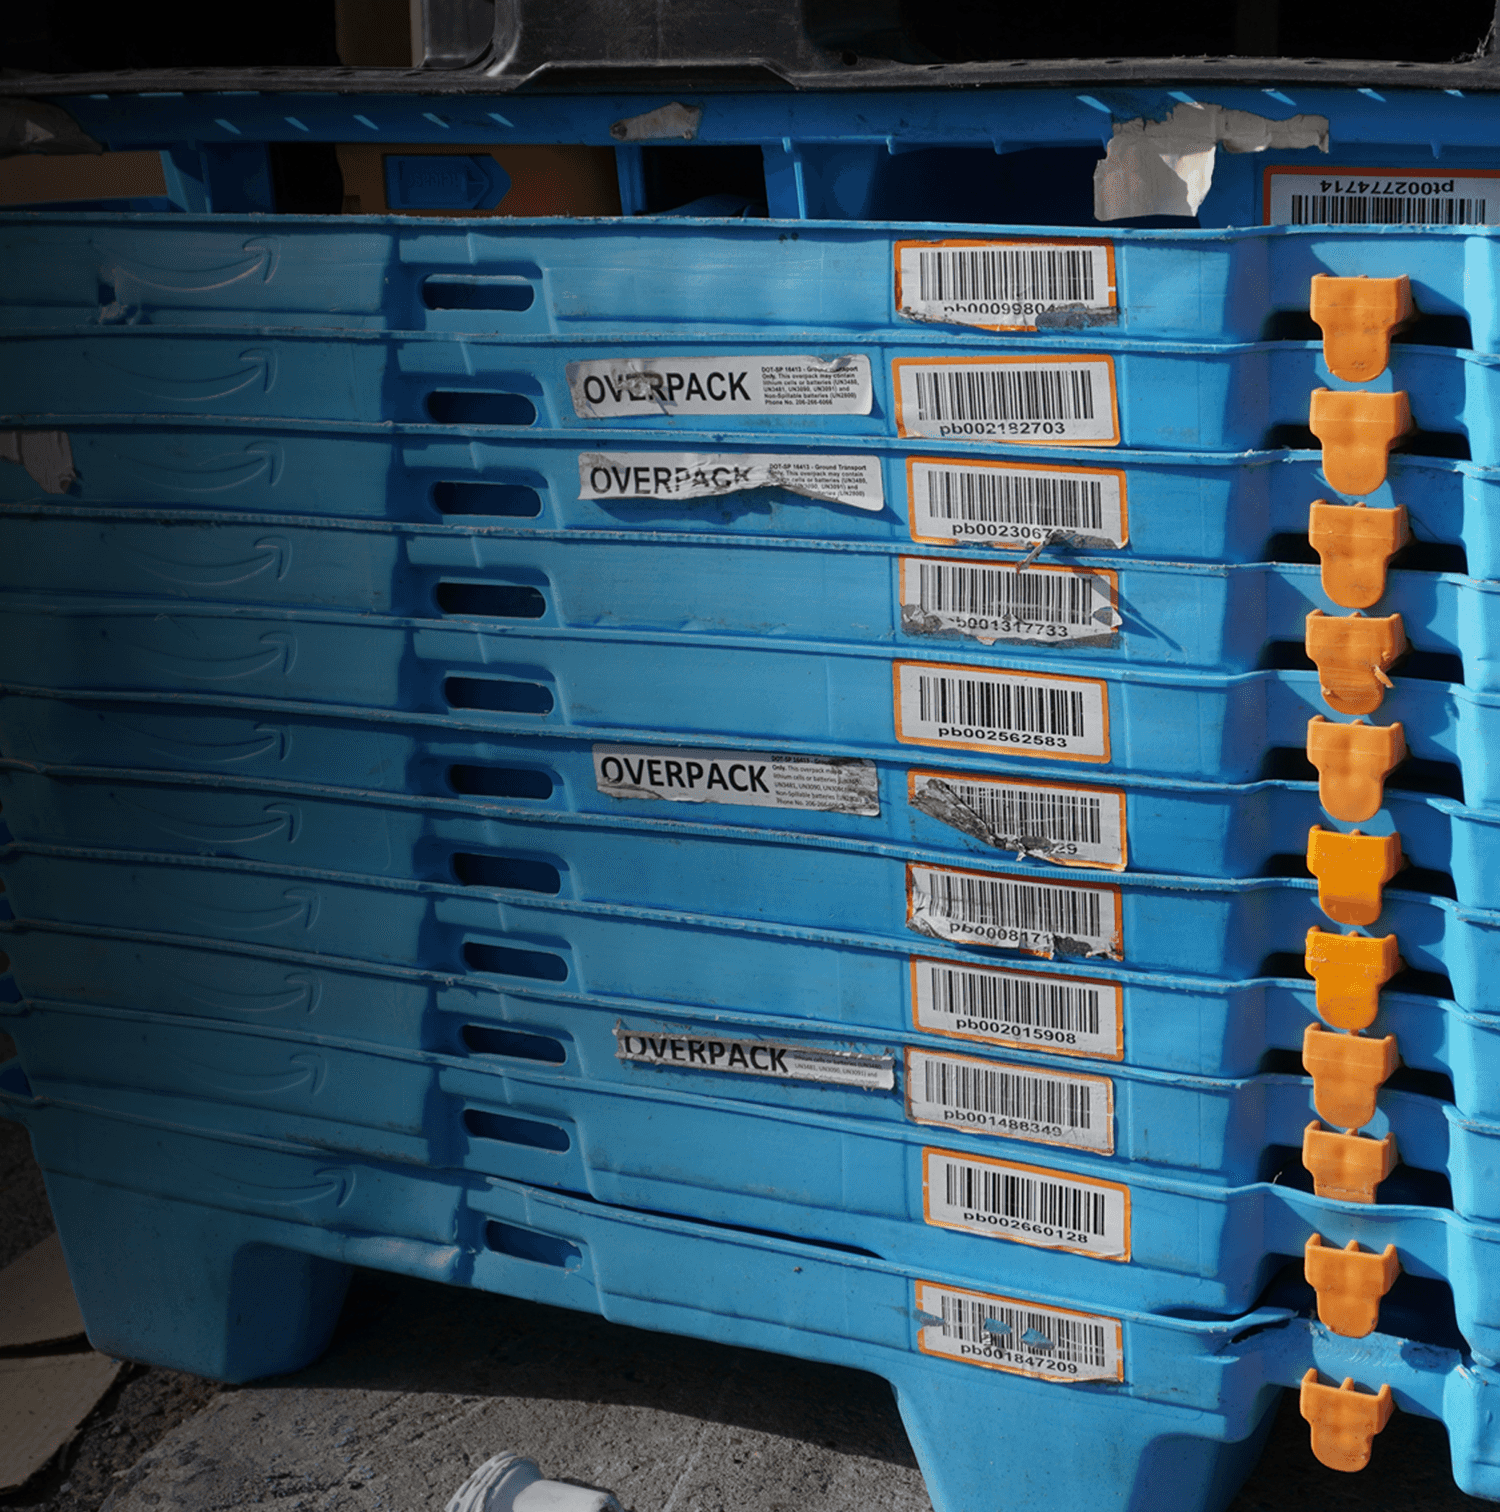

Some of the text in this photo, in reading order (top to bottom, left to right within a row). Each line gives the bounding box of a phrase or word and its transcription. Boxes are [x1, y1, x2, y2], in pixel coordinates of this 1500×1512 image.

[1319, 180, 1455, 195] pt002774714
[583, 371, 752, 405] OVERPACK
[939, 421, 1067, 437] pb002182703
[590, 465, 754, 495] OVERPACK
[952, 522, 1077, 540] pb0023067
[947, 616, 1069, 638] b001317733
[938, 726, 1068, 748] pb002562583
[601, 756, 771, 794] OVERPACK
[949, 922, 1053, 945] pb0008171
[956, 1018, 1077, 1045] pb002015908
[624, 1035, 789, 1074] OVERPACK
[943, 1109, 1063, 1138] pb001488349
[963, 1211, 1089, 1244] pb002660128
[960, 1343, 1079, 1375] pb001847209
